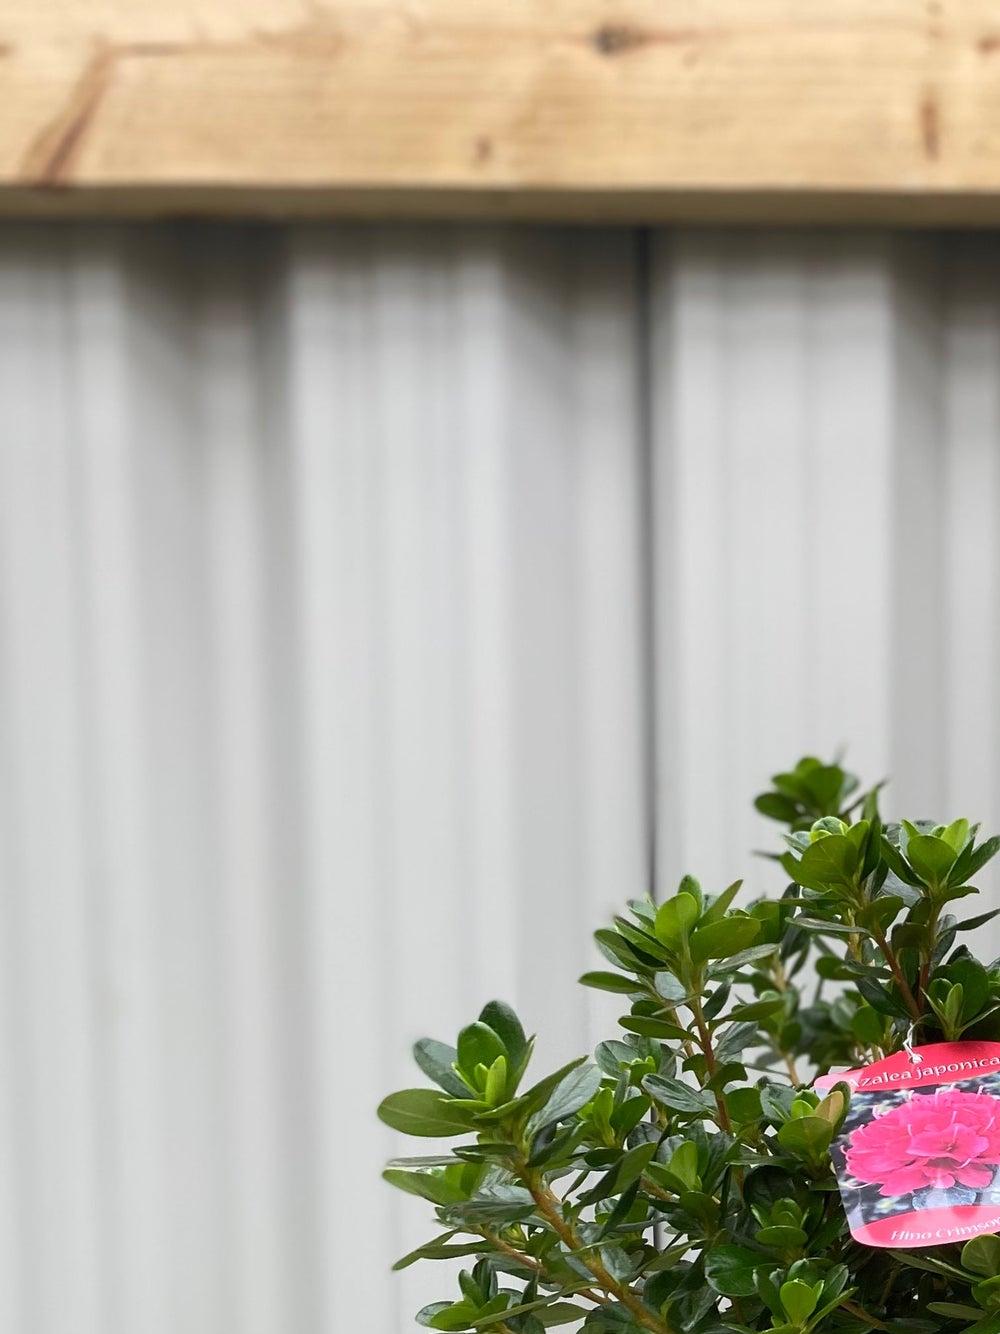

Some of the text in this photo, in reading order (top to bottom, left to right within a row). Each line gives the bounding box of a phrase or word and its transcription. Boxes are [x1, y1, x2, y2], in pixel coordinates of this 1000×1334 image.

[848, 1055, 1000, 1088] Azalea japonica
[889, 1228, 932, 1241] Hino
